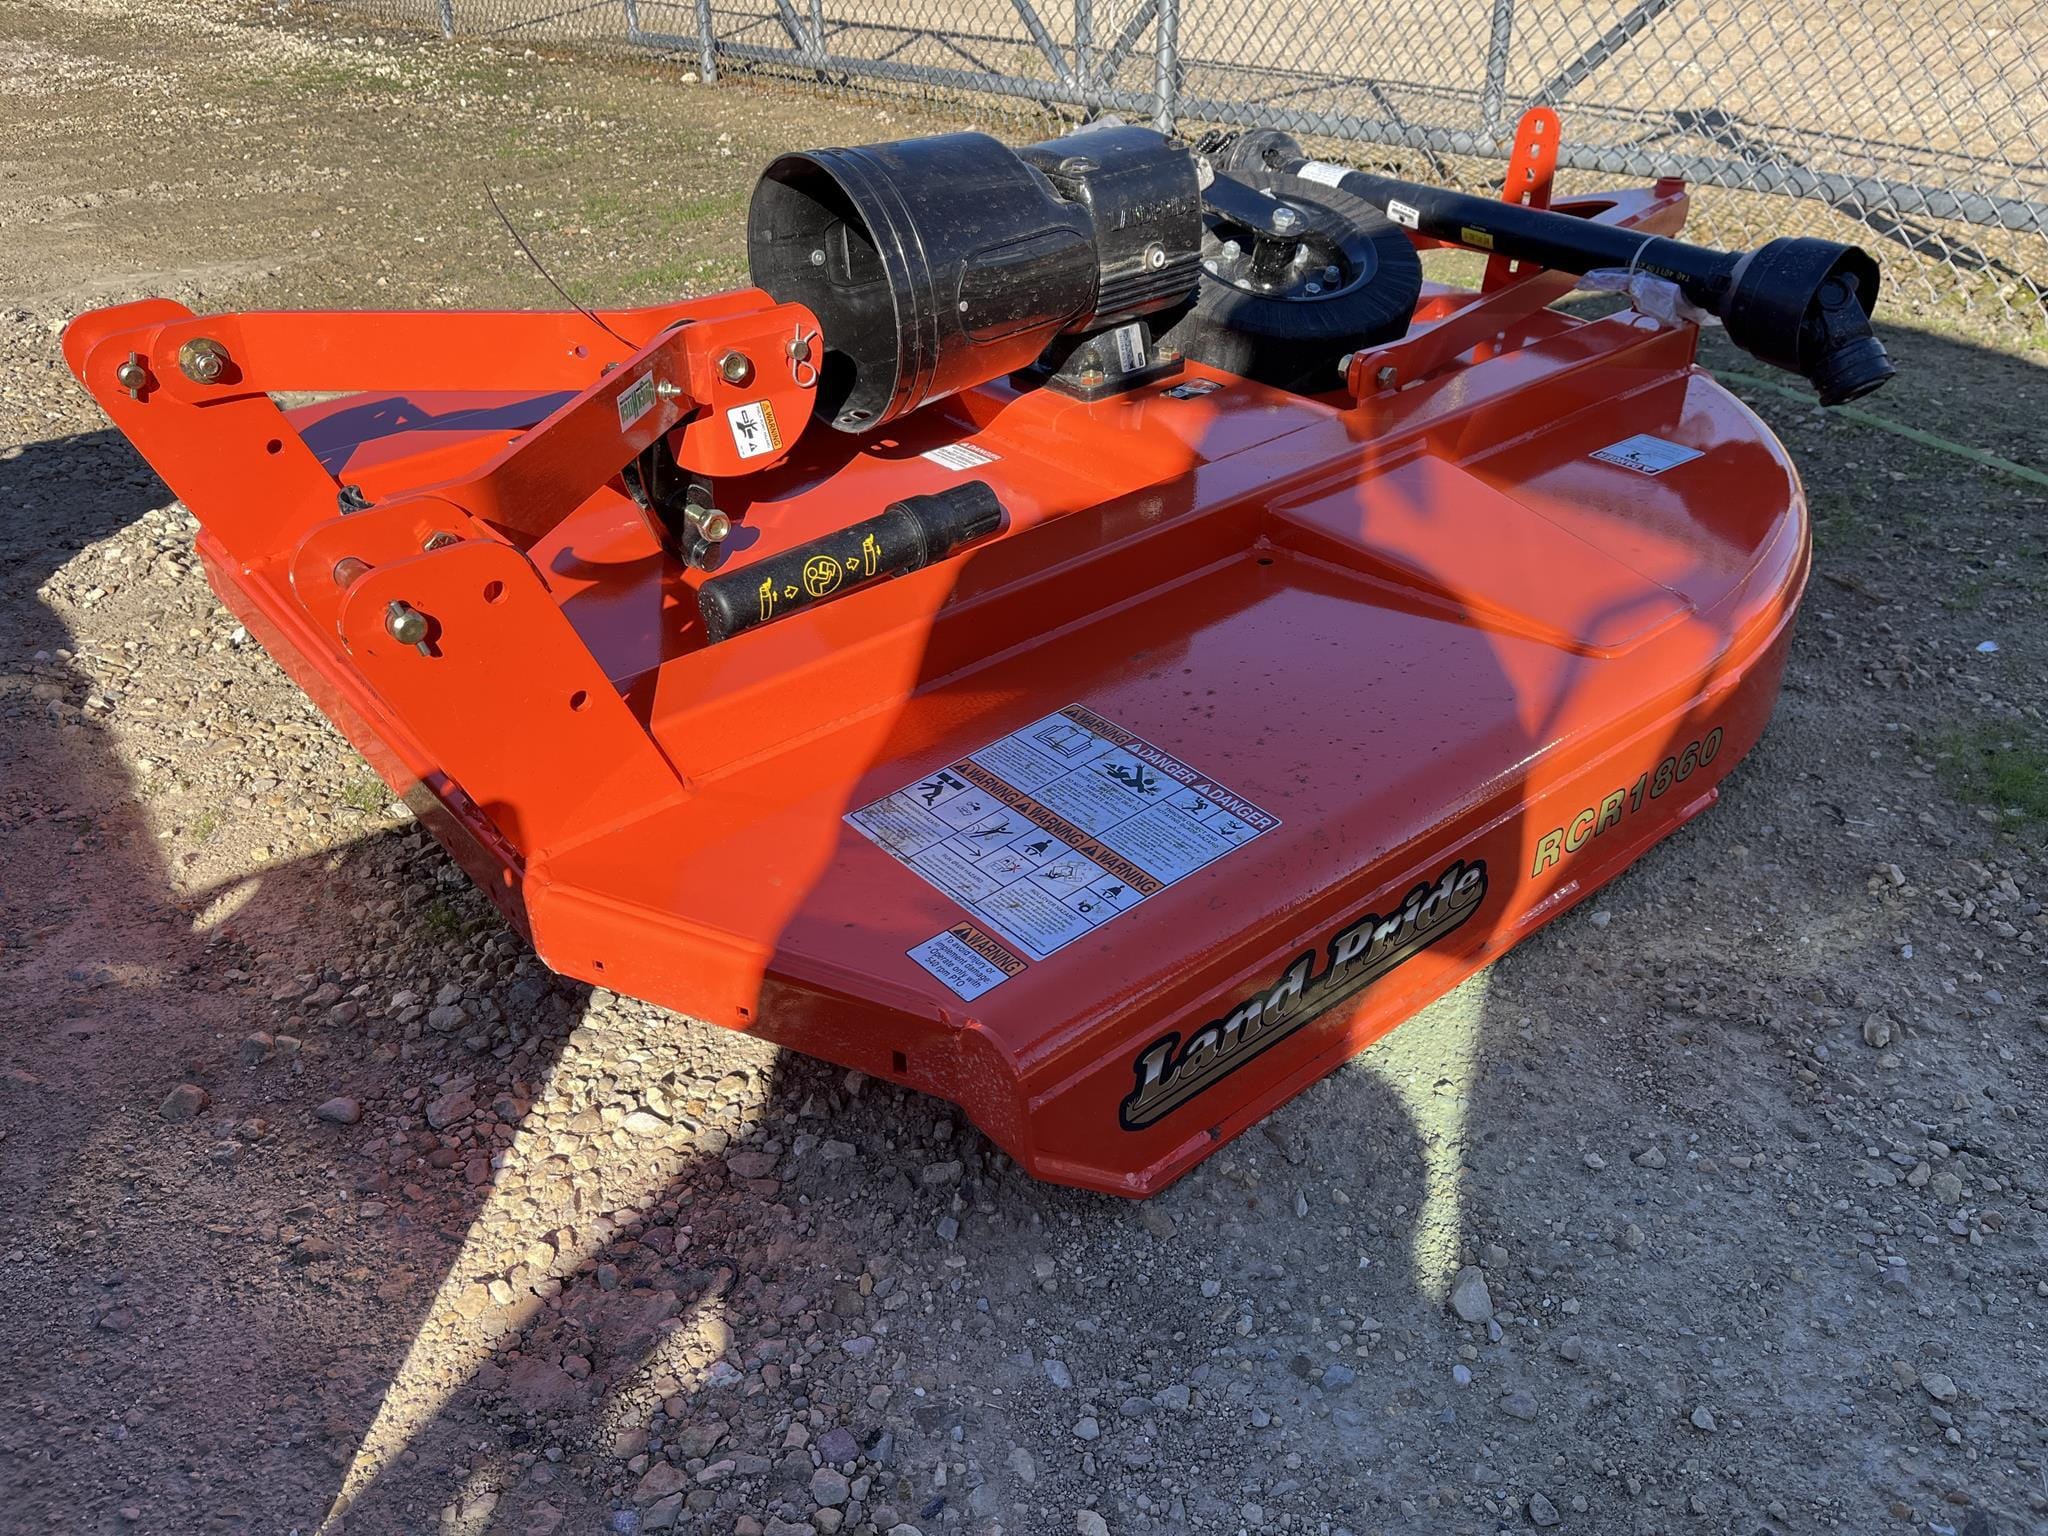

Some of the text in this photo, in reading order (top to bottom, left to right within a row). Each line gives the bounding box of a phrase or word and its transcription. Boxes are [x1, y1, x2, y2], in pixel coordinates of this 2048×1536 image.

[765, 411, 781, 446] WARNING
[1074, 712, 1130, 744] WARNING
[1137, 748, 1199, 783] DANGER
[964, 768, 1021, 802] WARNING
[1532, 726, 1724, 878] RCR1860
[1025, 807, 1086, 845] WARNING
[1205, 789, 1274, 828] DANGER
[1092, 850, 1159, 892] WARNING
[943, 935, 956, 943] To
[951, 941, 972, 955] avoid
[964, 933, 1022, 972] WARNING
[923, 955, 966, 987] 540 rpm PTO
[927, 947, 982, 988] Operate only with
[1130, 863, 1484, 1110] Land Pride
